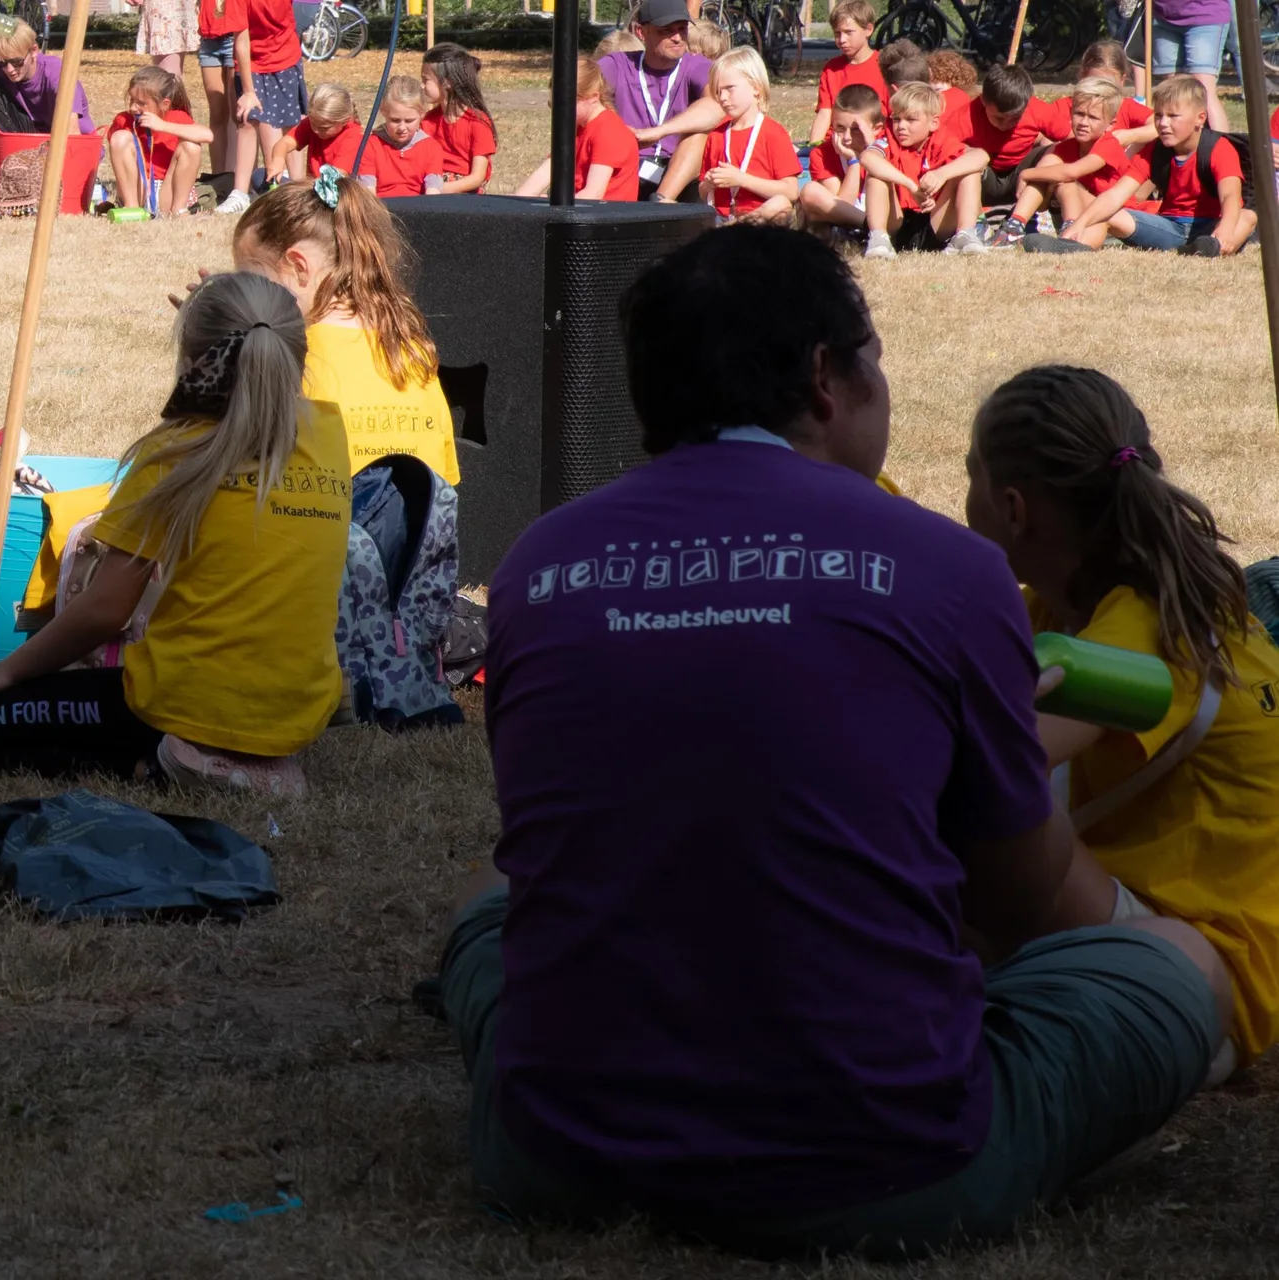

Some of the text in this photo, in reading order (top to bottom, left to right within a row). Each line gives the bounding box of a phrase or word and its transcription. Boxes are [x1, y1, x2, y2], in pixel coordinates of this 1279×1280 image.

[606, 534, 804, 552] STICHTING
[12, 700, 52, 724] FOR
[57, 701, 102, 724] FUN
